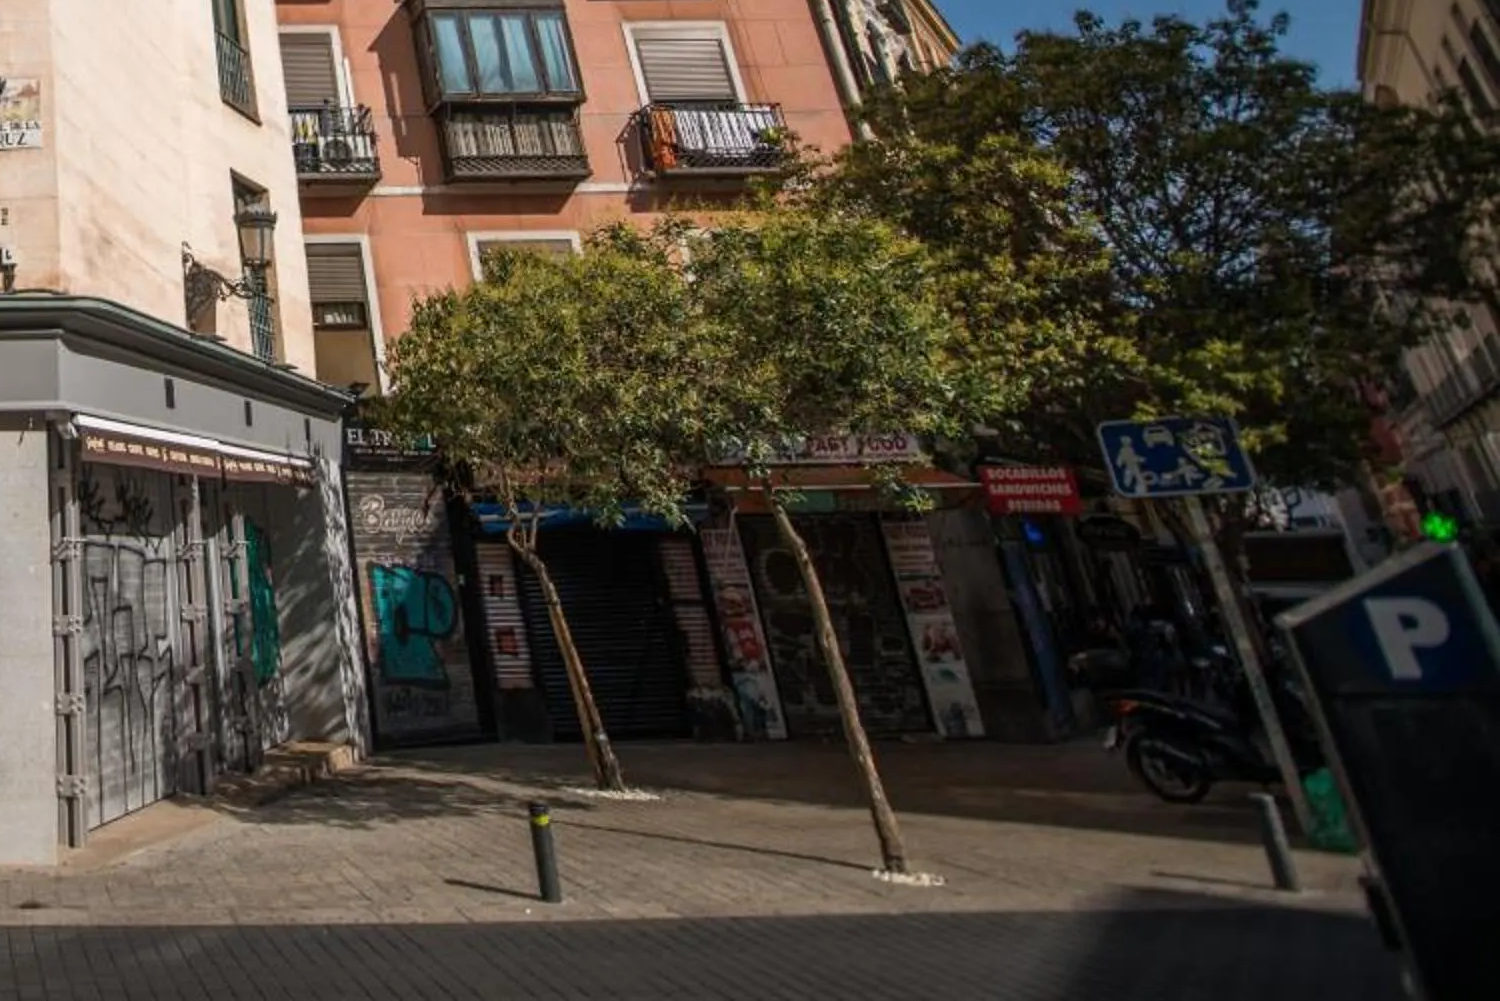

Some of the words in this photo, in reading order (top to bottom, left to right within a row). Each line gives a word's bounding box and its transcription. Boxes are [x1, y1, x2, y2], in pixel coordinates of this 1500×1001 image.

[987, 466, 1067, 481] BOCADILLOS
[988, 482, 1073, 496] SANDWICHES
[1362, 596, 1450, 680] P
